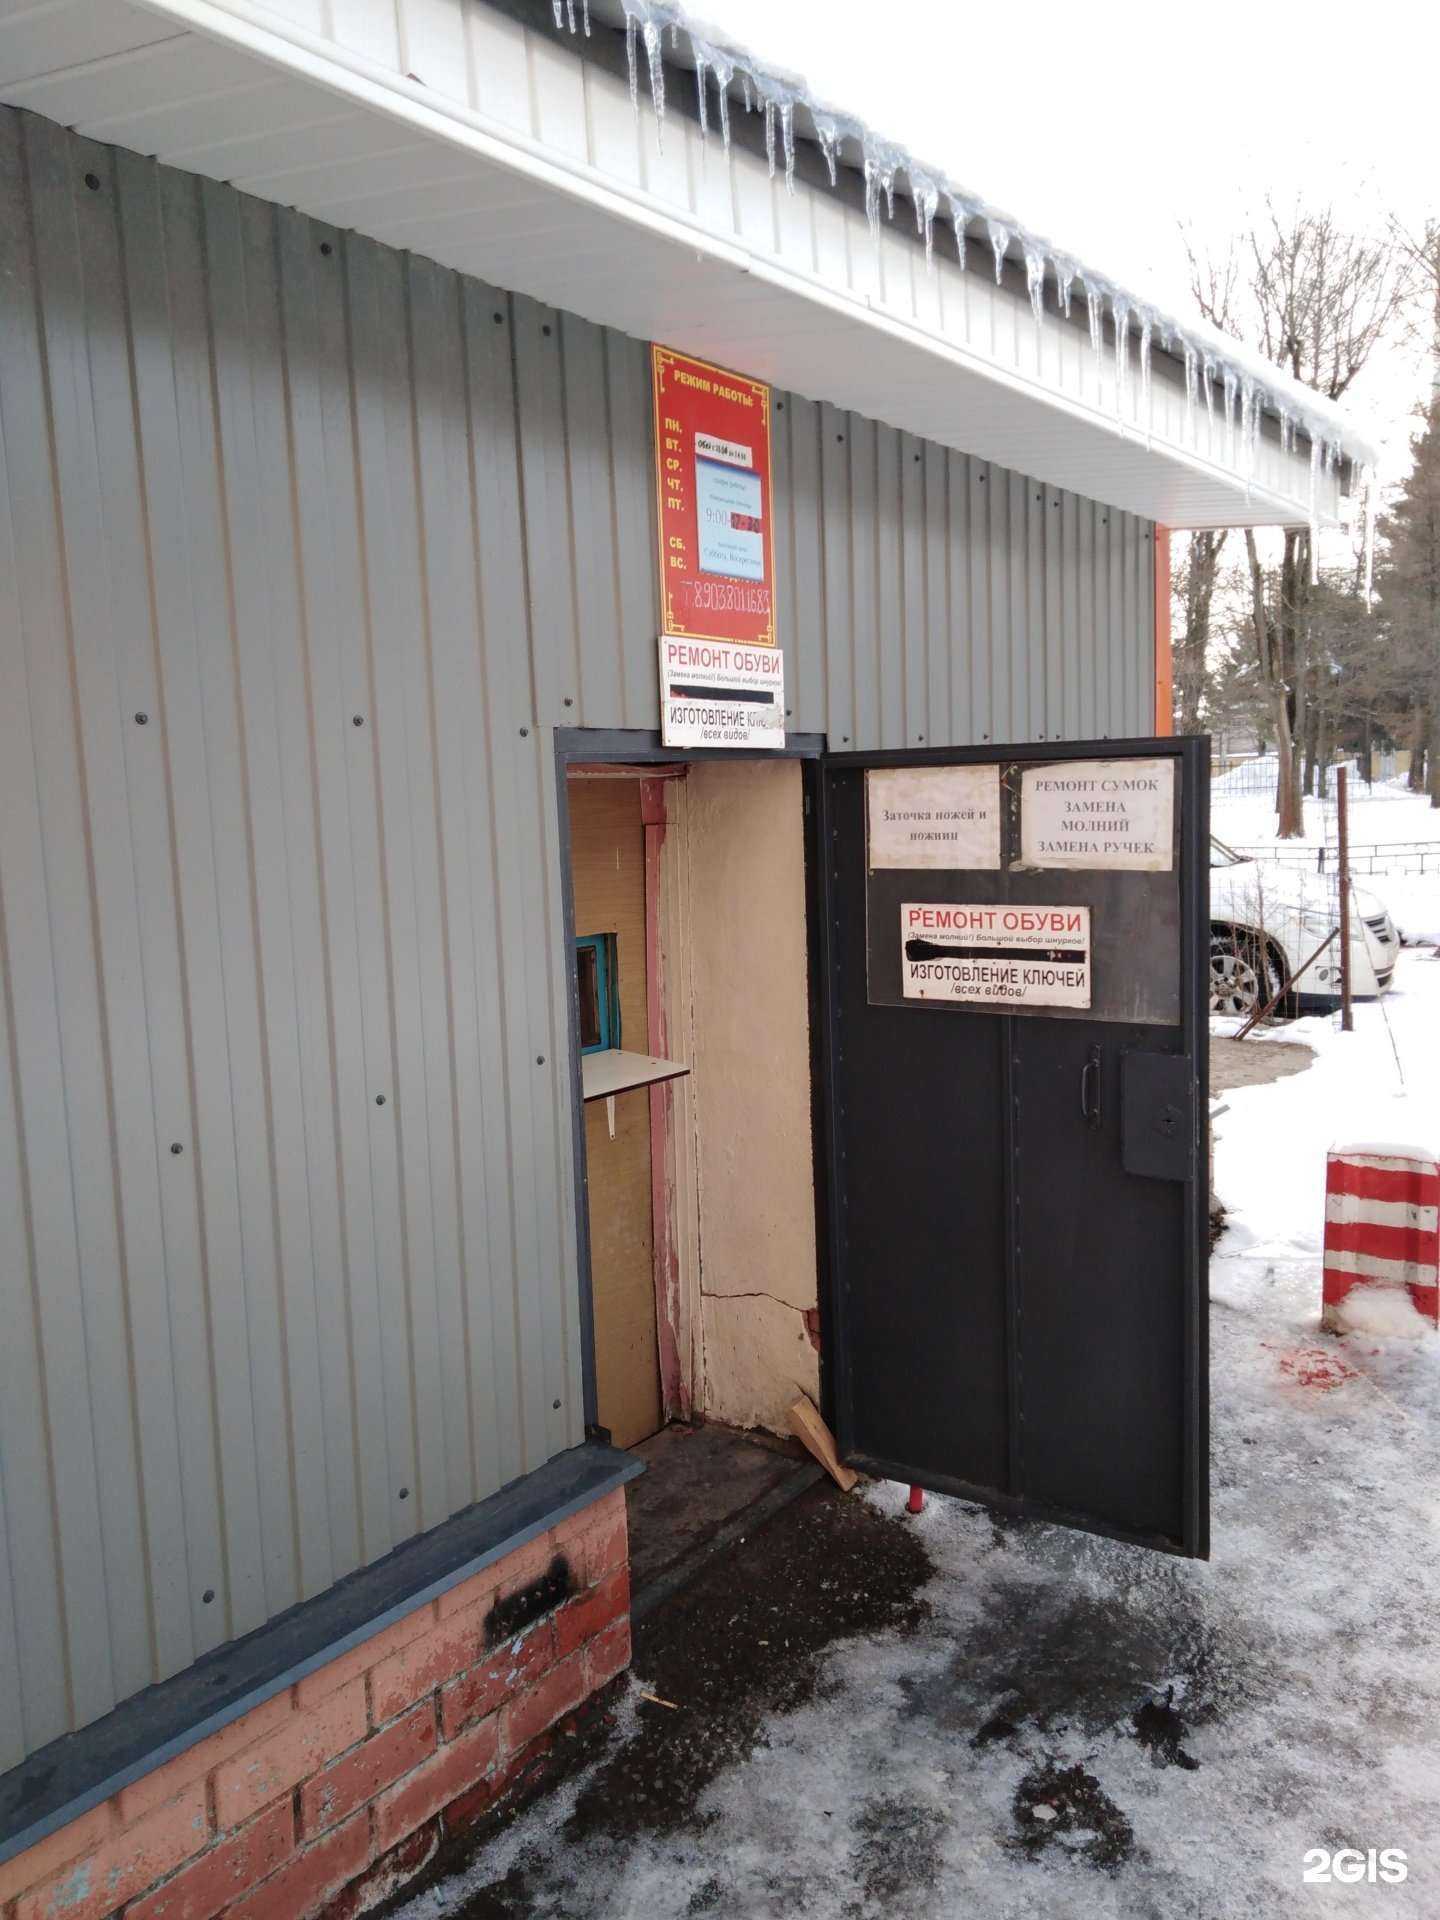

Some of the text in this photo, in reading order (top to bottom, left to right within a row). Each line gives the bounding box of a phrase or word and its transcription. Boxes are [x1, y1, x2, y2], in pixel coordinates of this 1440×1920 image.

[674, 369, 711, 393] РЕЖИМ
[665, 418, 682, 434] ПН.
[665, 438, 682, 453] ВТ.
[666, 457, 683, 472] СР.
[667, 477, 684, 492] ЧТ.
[668, 497, 685, 511] ПТ.
[669, 536, 686, 551] СБ.
[670, 556, 687, 570] ВС.
[668, 644, 780, 674] РЕМОНТ ОБУВИ
[670, 706, 745, 727] ИЗГОТОВЛЕНИЕ
[1035, 779, 1159, 792] РЕМОНТ СУМОК
[882, 808, 987, 821] Заточка ножей и
[1064, 801, 1126, 813] ЗАМЕНА
[1061, 819, 1129, 832] МОЛНИЙ
[1038, 841, 1155, 854] ЗАМЕНА РУЧЕК
[909, 909, 1081, 932] РЕМОНТ ОБУВИ
[976, 933, 1013, 943] Большой
[1016, 935, 1043, 945] выбор
[910, 963, 1085, 987] ИЗГОТОВЛЕНИЕ КЛЮЧЕЙ
[950, 983, 981, 995] /всех
